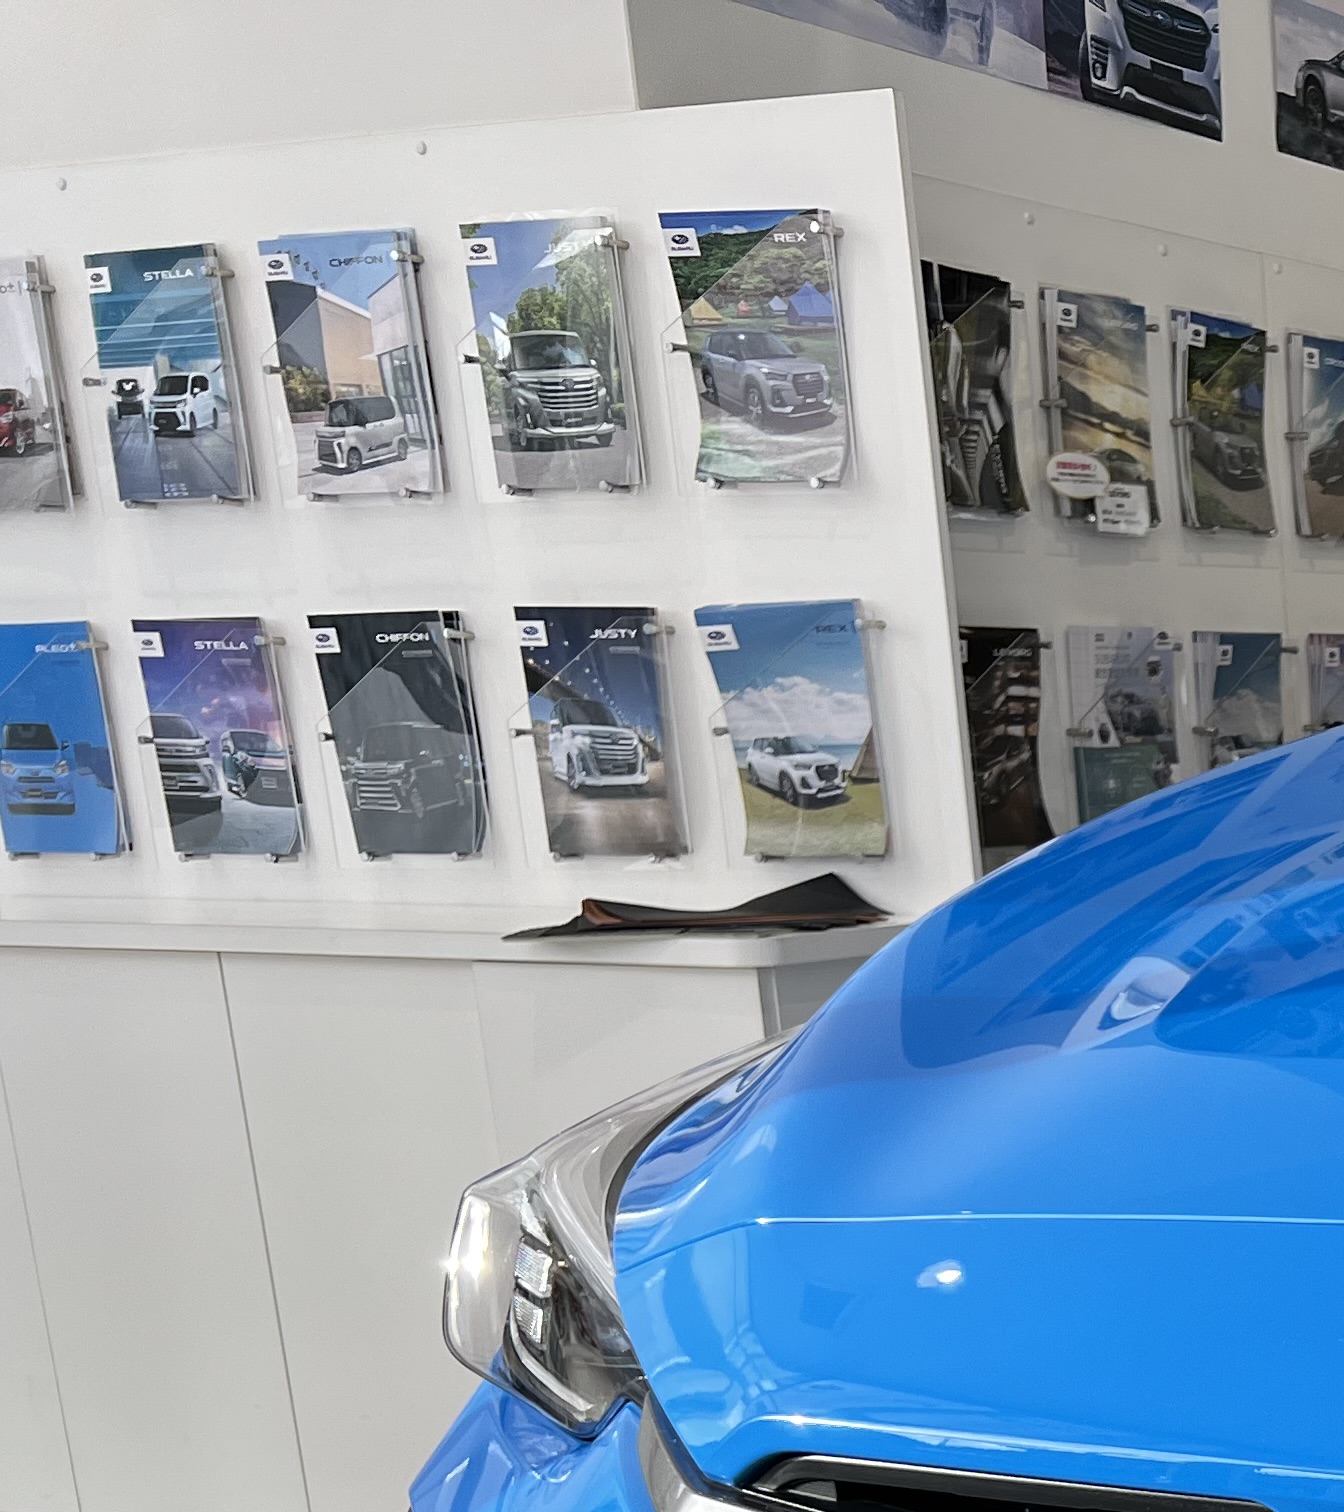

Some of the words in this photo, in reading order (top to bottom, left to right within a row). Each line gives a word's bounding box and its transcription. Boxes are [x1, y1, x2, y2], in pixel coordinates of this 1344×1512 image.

[773, 231, 807, 243] REX
[329, 256, 383, 268] CHIFFON
[143, 268, 194, 282] STELLA
[375, 632, 430, 643] CHIFFON
[589, 628, 638, 639] JUSTY
[194, 640, 249, 651] STELLA
